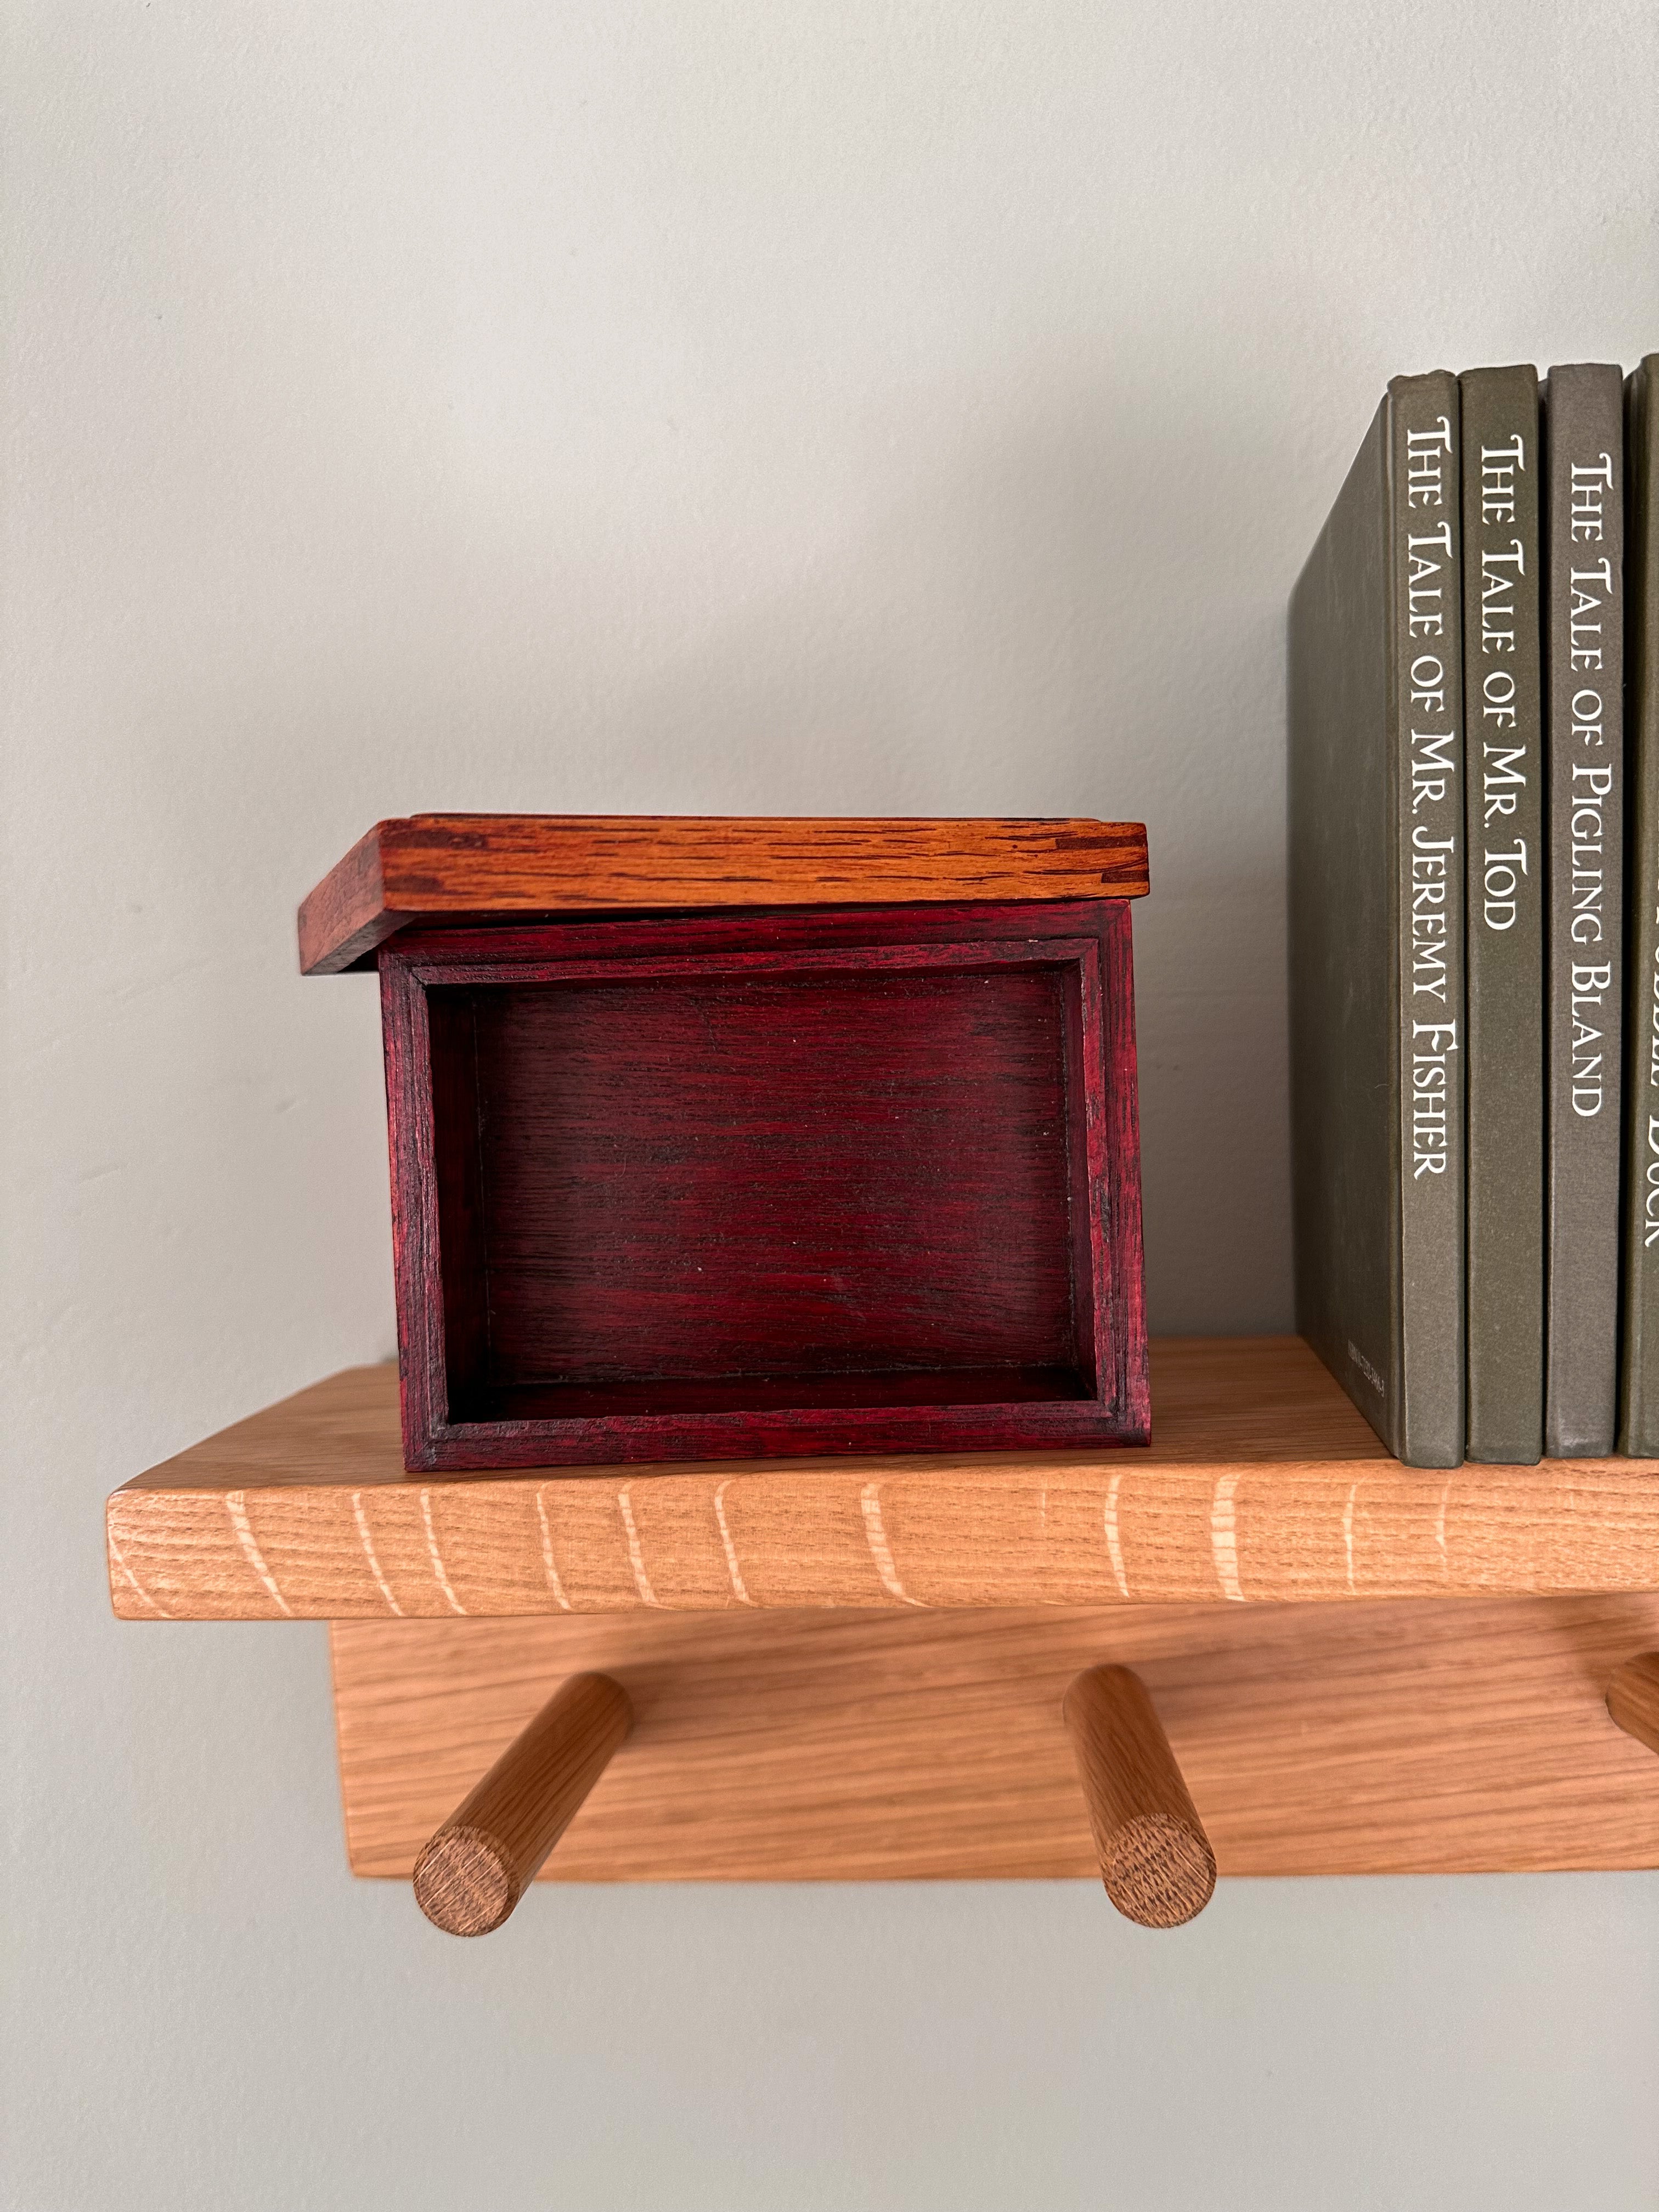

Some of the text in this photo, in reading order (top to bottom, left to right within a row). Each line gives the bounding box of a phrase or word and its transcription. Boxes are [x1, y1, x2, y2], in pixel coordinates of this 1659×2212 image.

[1407, 416, 1459, 1181] THE TALE OF MR. JEREMY FISHER
[1481, 434, 1528, 930] THE TALE OF MR. TOD
[1570, 452, 1613, 1117] THE TALE OF PIGLING BLAND
